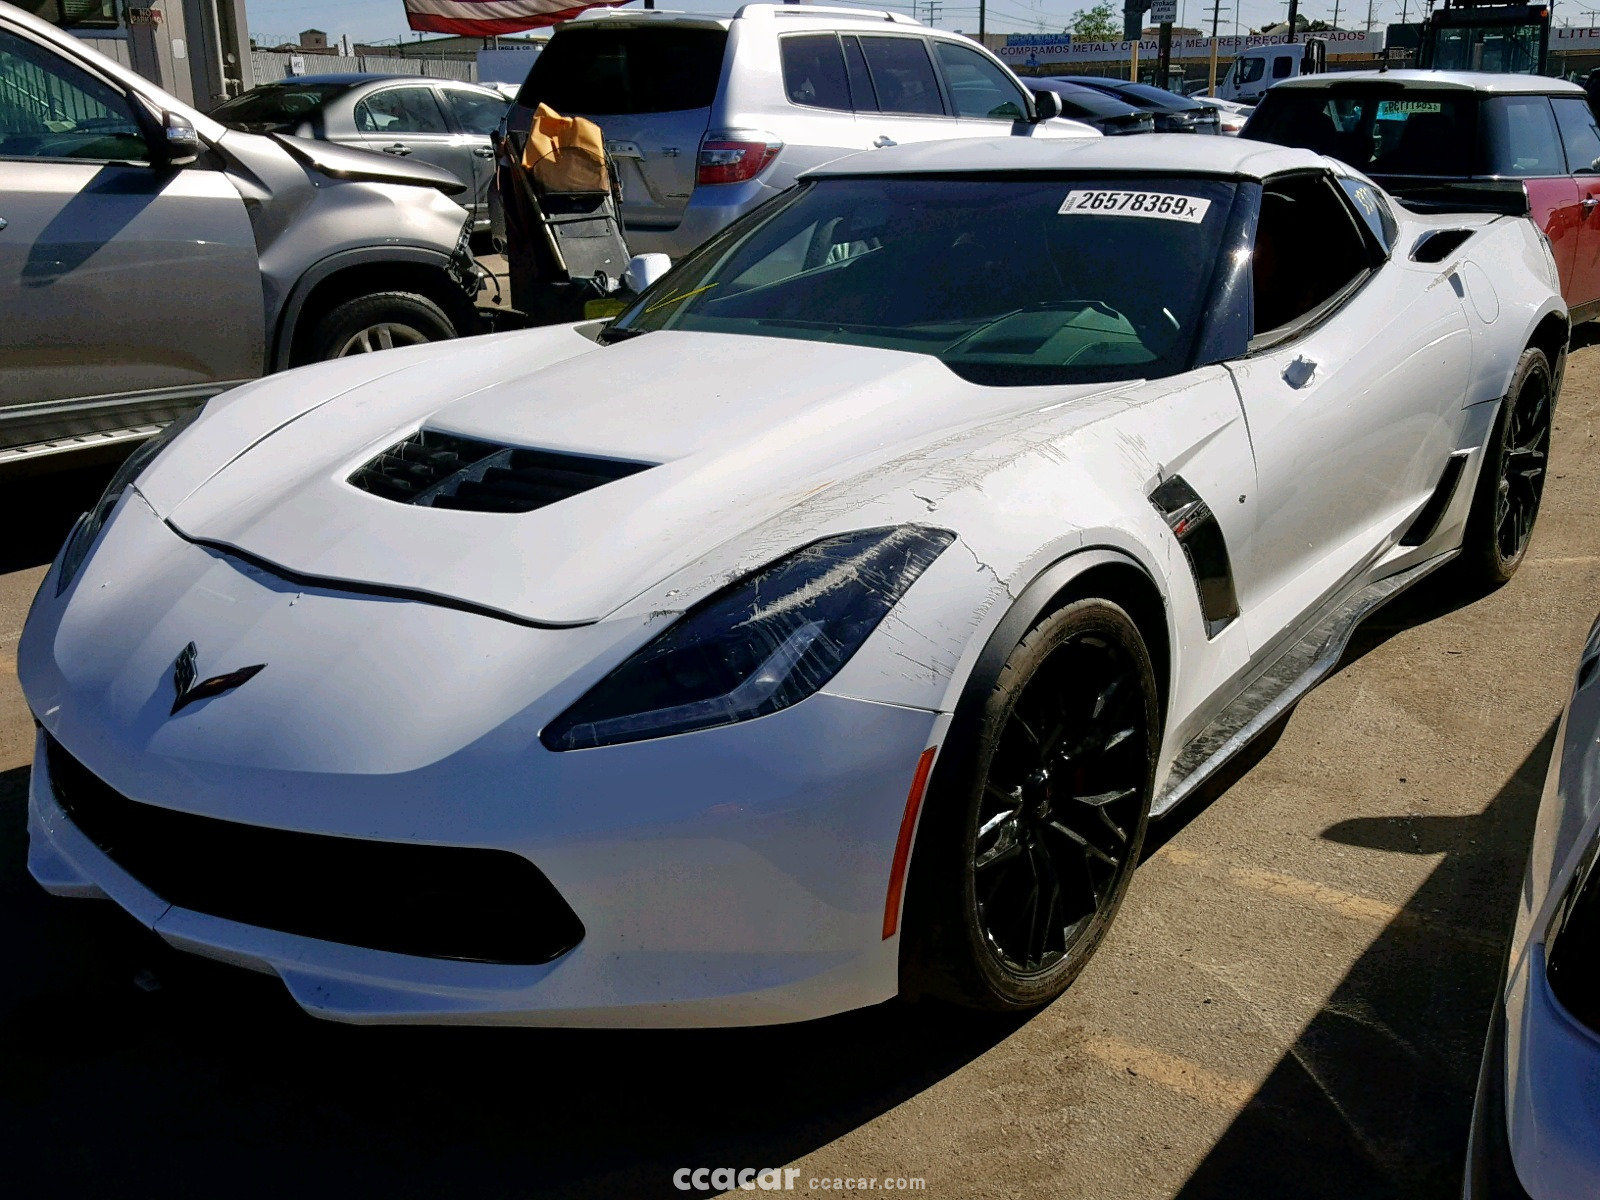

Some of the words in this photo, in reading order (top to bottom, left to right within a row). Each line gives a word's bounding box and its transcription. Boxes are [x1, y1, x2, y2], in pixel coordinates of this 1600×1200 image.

[139, 8, 152, 16] NO
[1558, 28, 1600, 39] LITE
[1000, 44, 1070, 56] COMPRAMOS
[1072, 43, 1107, 53] METAL
[1110, 43, 1117, 51] Y
[1185, 36, 1242, 48] MEJRES
